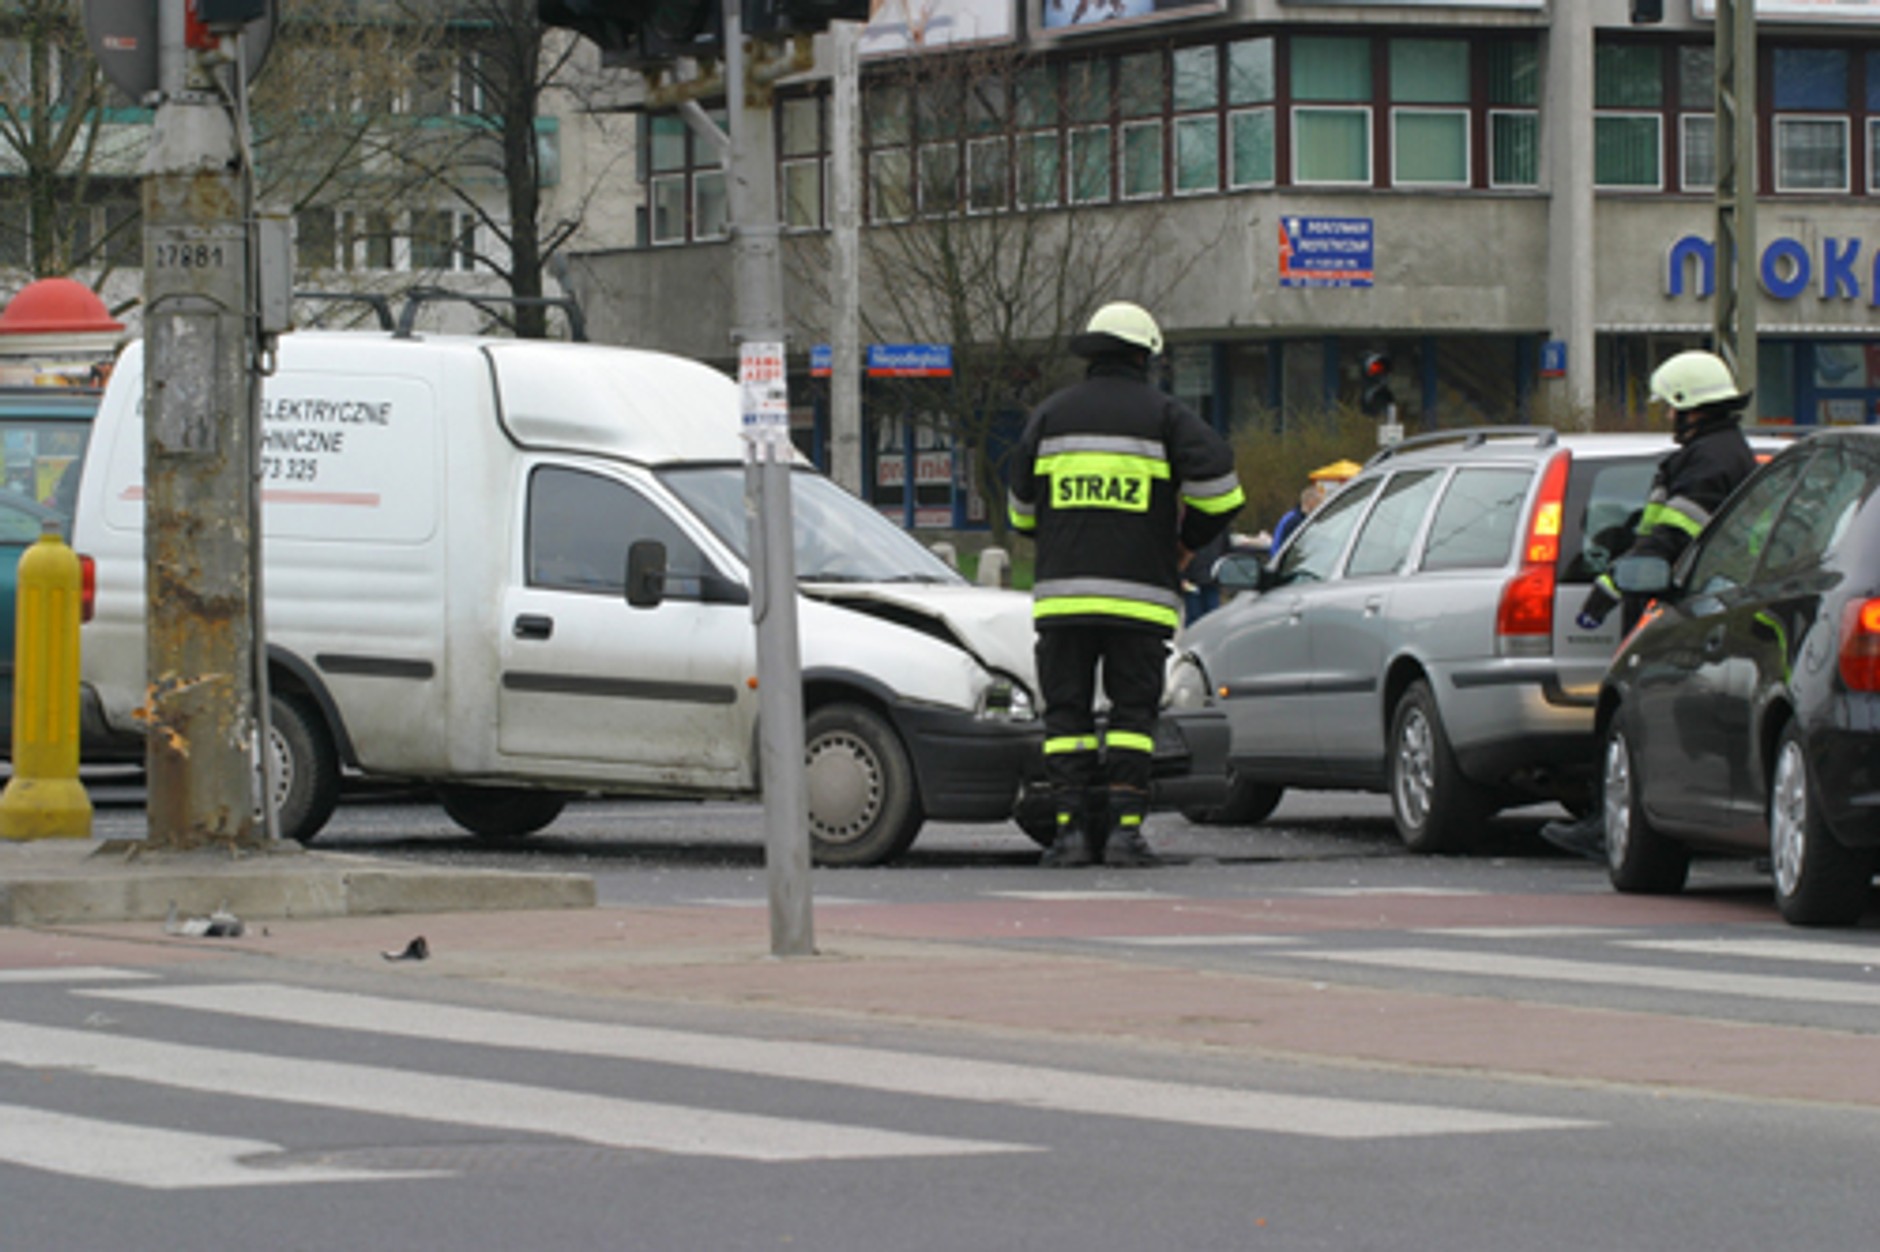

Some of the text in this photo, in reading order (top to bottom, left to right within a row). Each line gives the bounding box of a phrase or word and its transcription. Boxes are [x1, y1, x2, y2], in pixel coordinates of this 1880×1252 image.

[260, 429, 343, 453] HNICZNE
[261, 457, 318, 481] 73 325
